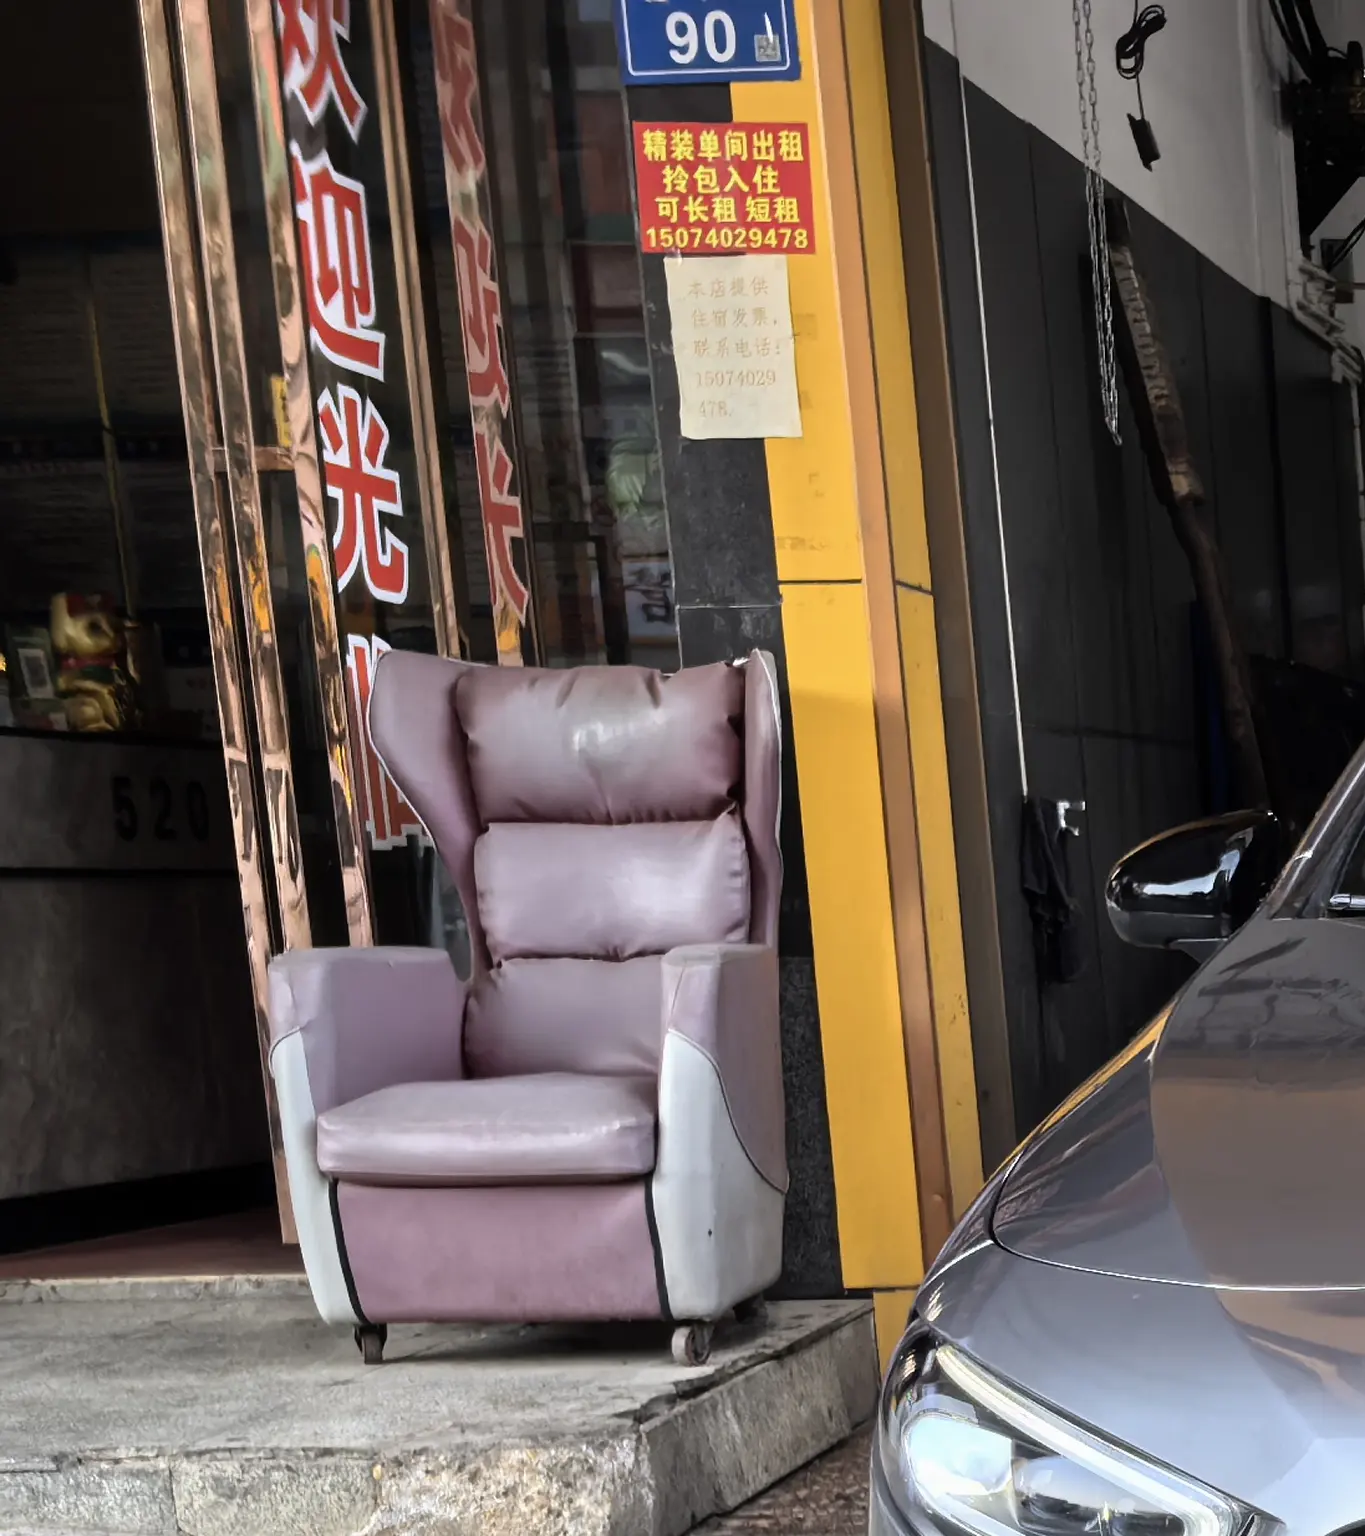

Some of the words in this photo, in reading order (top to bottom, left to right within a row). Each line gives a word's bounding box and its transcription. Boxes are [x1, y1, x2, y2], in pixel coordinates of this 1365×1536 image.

[666, 10, 736, 64] 90
[642, 129, 804, 162] 精装单间出租
[662, 164, 780, 194] 拎包入住
[646, 227, 808, 248] 15074029478
[688, 276, 769, 298] 本店提供
[696, 370, 776, 388] 15074029
[112, 775, 209, 842] 520
